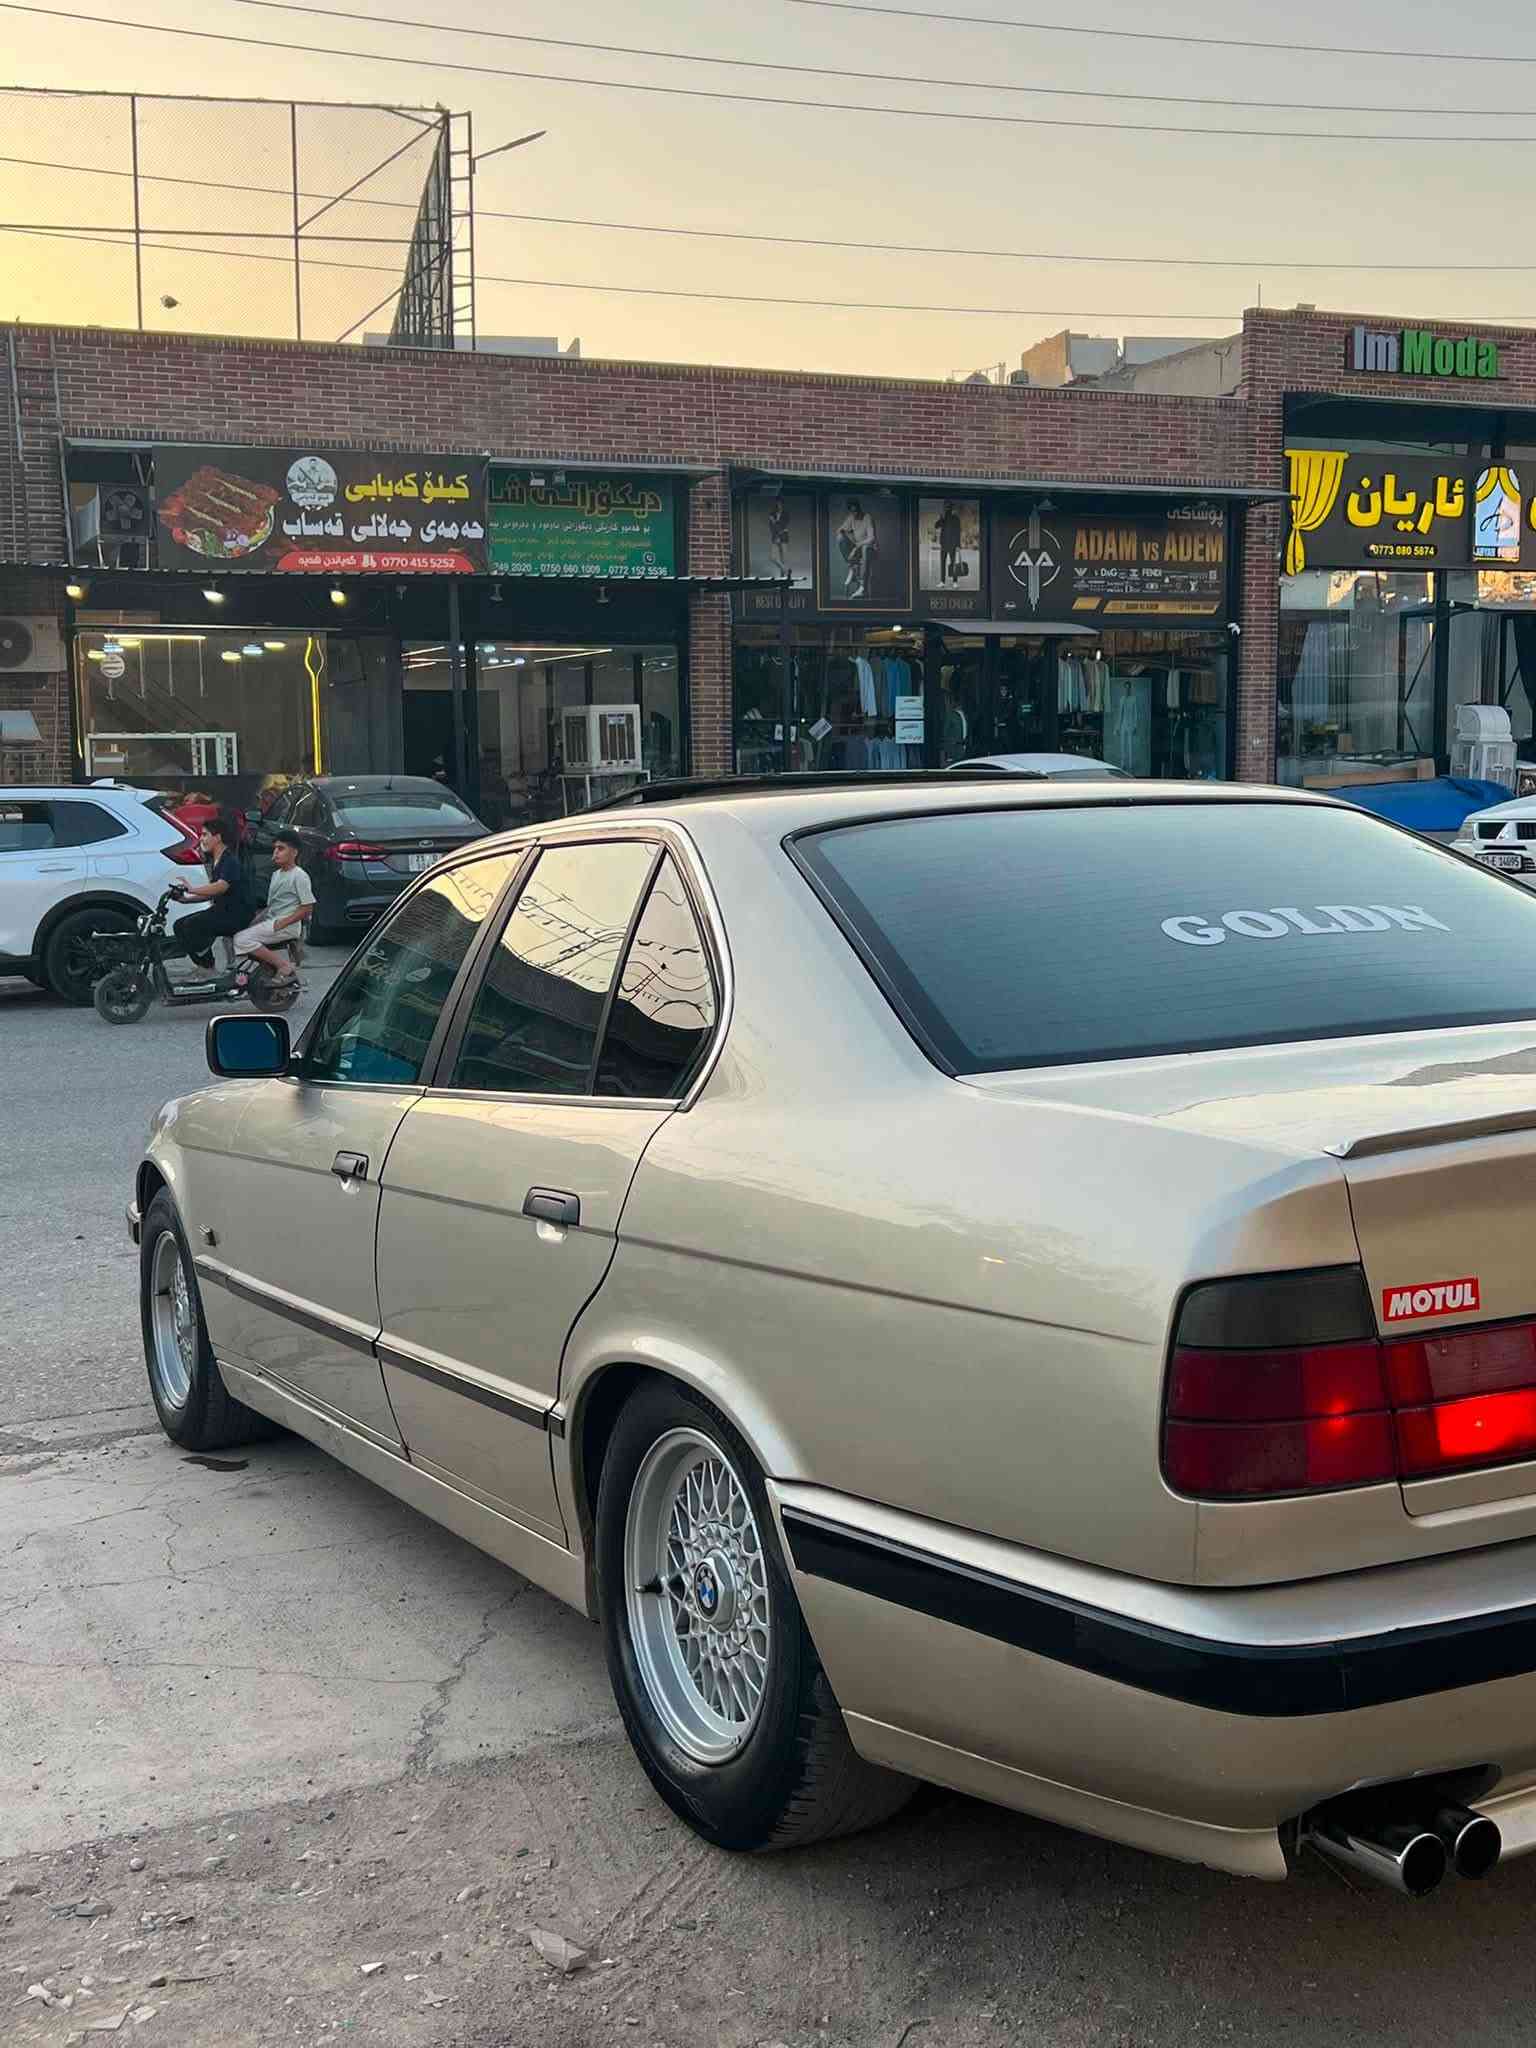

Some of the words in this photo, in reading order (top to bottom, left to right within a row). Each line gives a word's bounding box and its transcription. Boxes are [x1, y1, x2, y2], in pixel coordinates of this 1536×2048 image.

[381, 557, 408, 567] 0770
[410, 557, 428, 568] 415
[430, 558, 455, 569] 5252
[1074, 528, 1137, 561] ADAM
[1163, 530, 1224, 563] ADEM
[1388, 1283, 1477, 1318] MOTUL
